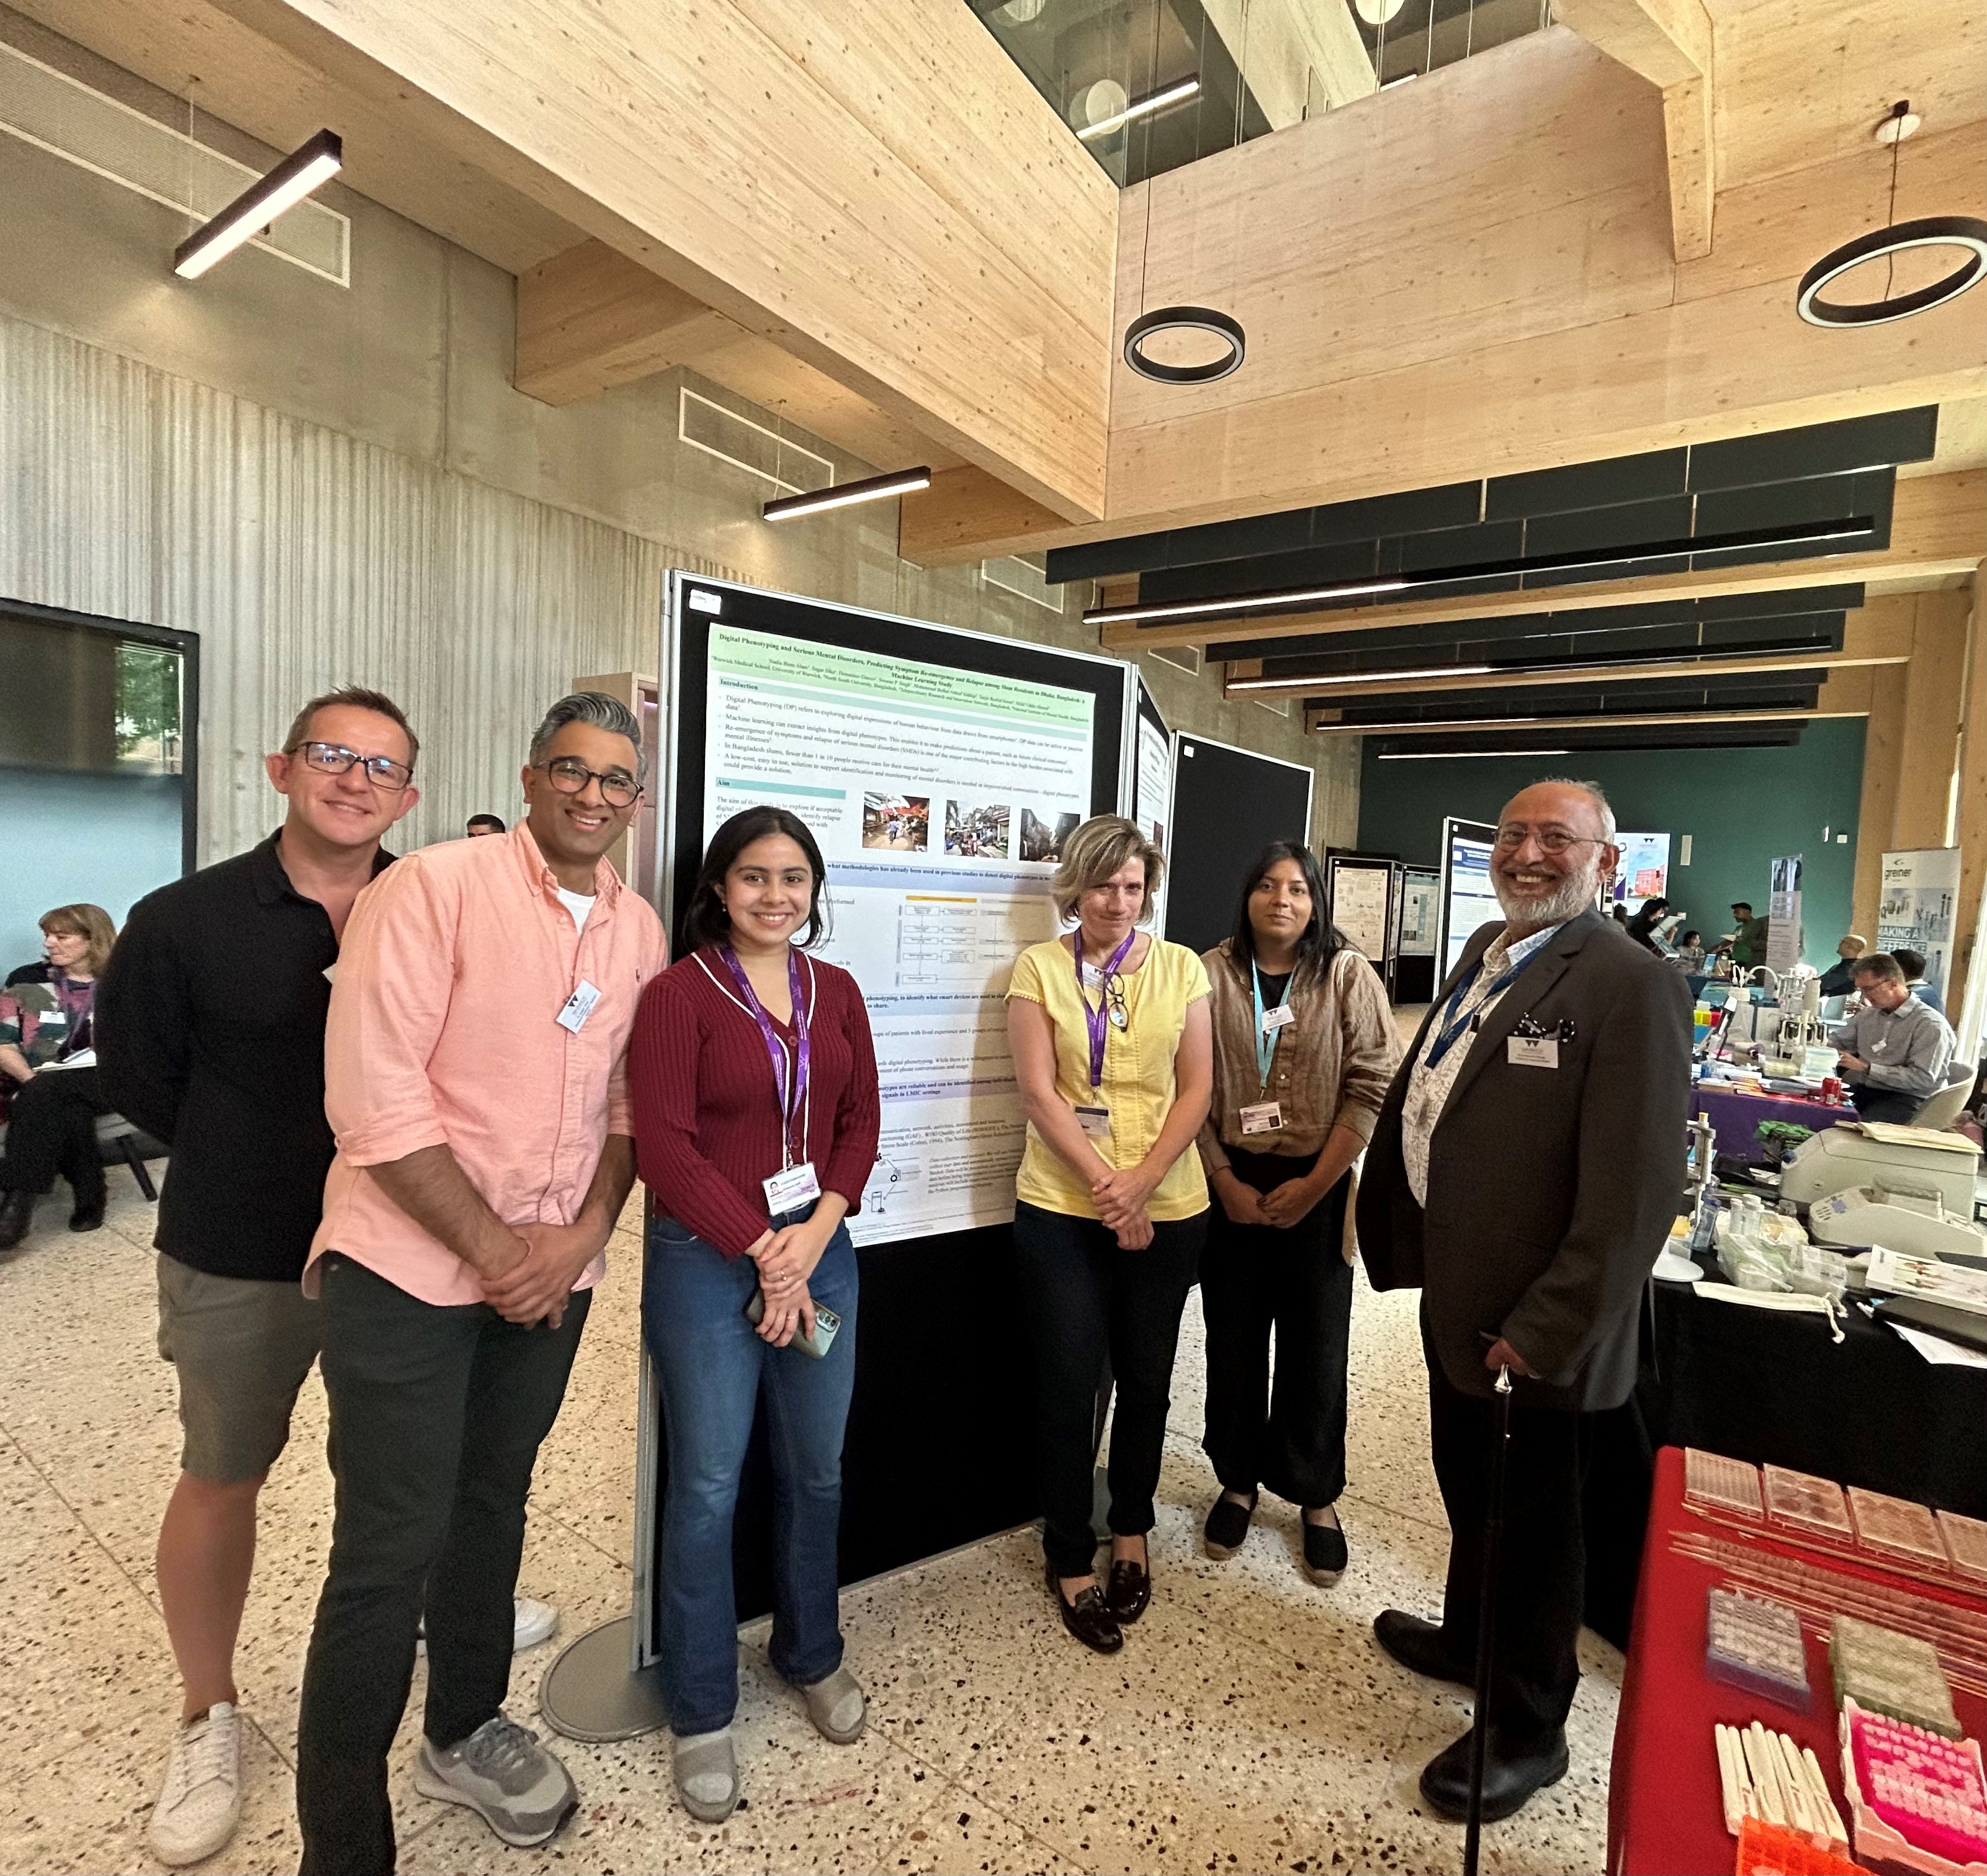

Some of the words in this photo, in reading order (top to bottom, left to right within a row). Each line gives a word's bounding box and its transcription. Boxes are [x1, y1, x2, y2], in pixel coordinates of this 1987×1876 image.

[720, 634, 740, 642] Digital
[742, 638, 779, 650] Phenotyping
[793, 647, 815, 655] Serious
[816, 651, 836, 659] Mental
[838, 655, 865, 665] Disorders,
[866, 660, 894, 670] Predicting
[895, 665, 919, 674] Symptom
[720, 679, 758, 690] Introduction
[914, 676, 937, 686] Learning
[938, 681, 952, 689] Study
[726, 695, 746, 703] Digital
[748, 698, 783, 709] Phenotyping
[821, 711, 845, 719] exploring
[725, 724, 766, 734] Re-emergence
[726, 714, 750, 722] Machine
[751, 717, 774, 727] learning
[807, 725, 827, 733] insights
[732, 743, 765, 752] Bangladesh
[730, 753, 756, 762] low-cost,
[841, 766, 874, 774] identification
[1885, 869, 1912, 880] greiner
[1912, 928, 1919, 938] A
